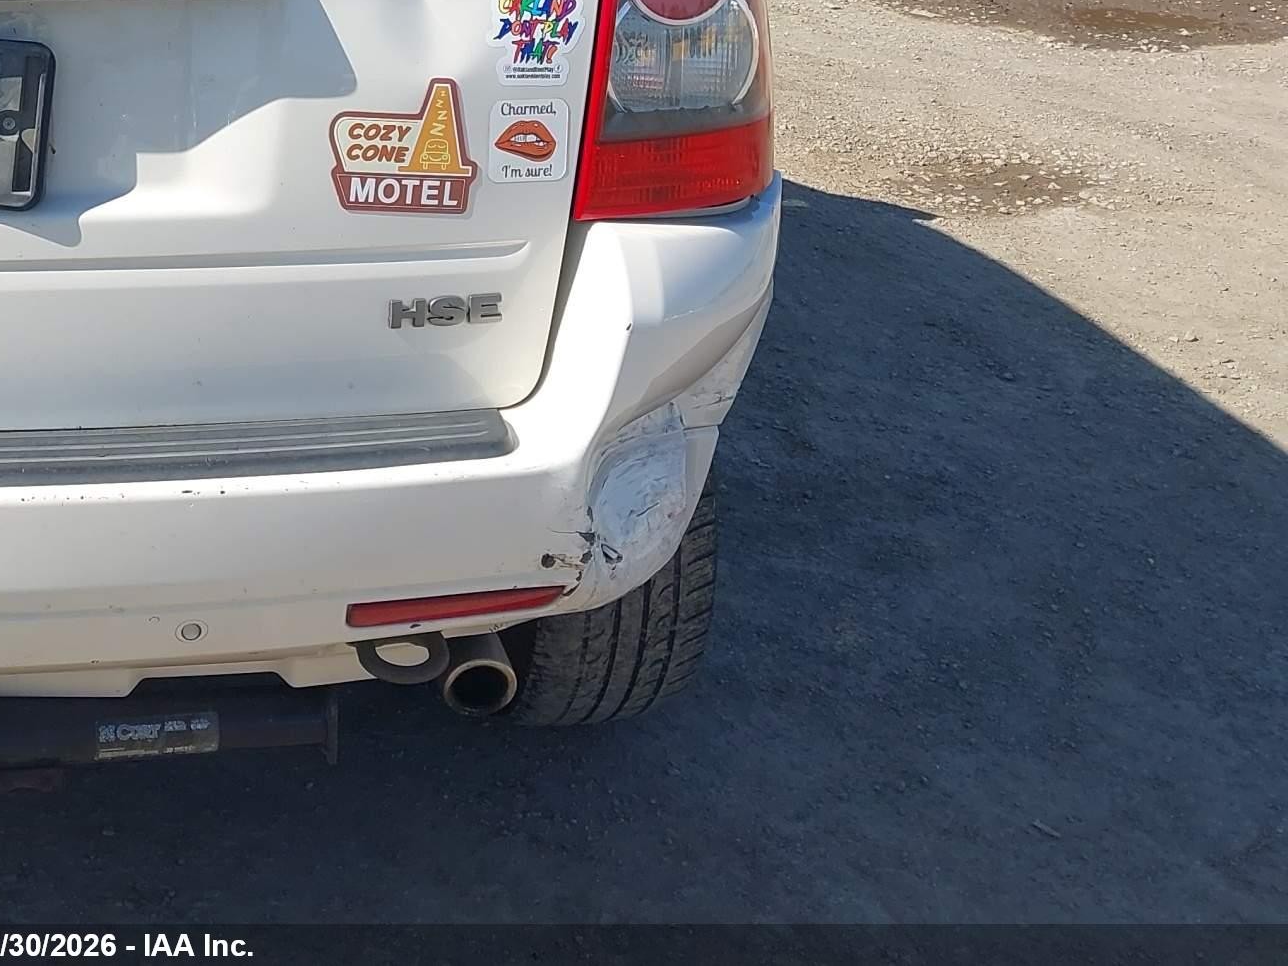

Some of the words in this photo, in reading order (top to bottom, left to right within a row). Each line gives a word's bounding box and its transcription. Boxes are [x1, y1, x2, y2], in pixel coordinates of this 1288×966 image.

[541, 18, 579, 46] PLAY
[511, 38, 560, 65] THAT!
[500, 101, 557, 117] Charmed,
[347, 123, 412, 142] COZY
[346, 143, 409, 164] CONE
[501, 164, 523, 179] I'm
[524, 164, 553, 179] sure!
[348, 176, 459, 206] MOTEL
[388, 292, 503, 329] HSE
[116, 723, 162, 741] CURT
